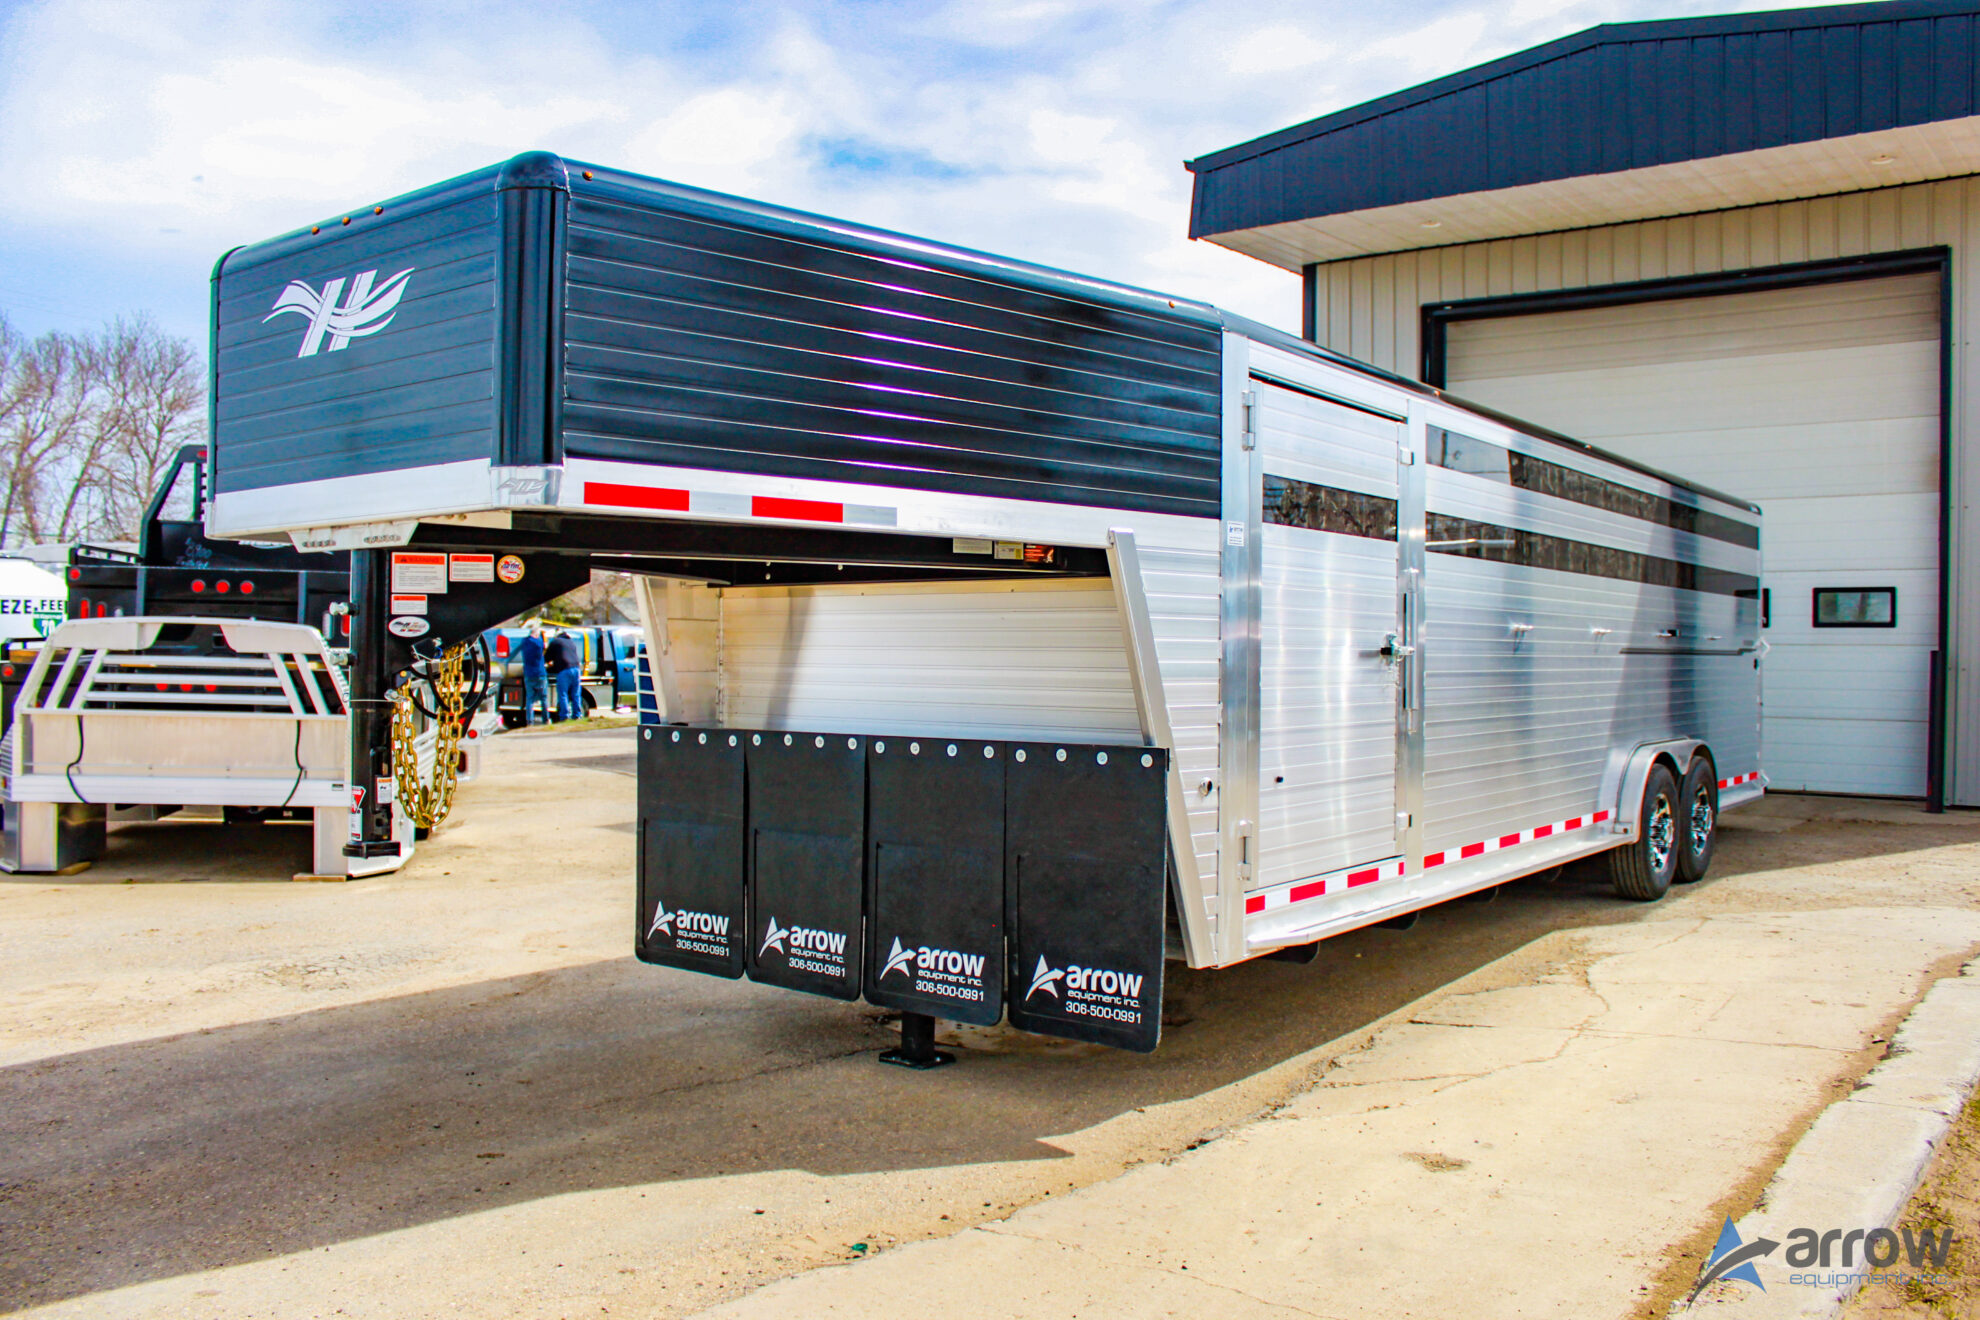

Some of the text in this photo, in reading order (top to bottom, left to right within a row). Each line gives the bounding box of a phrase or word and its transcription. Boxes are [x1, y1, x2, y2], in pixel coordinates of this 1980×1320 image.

[676, 909, 730, 936] arrow
[676, 938, 730, 957] 306-500-0991
[677, 930, 729, 944] equipment inc.
[789, 925, 847, 955] arrow
[790, 947, 845, 964] equipment inc.
[916, 946, 985, 978] arrow
[788, 957, 846, 978] 306-500-0991
[917, 969, 984, 987] equipment inc.
[915, 980, 984, 1002] 306-500-0991
[1066, 965, 1143, 998] arrow
[1067, 989, 1141, 1008] equipment inc.
[1065, 1001, 1142, 1024] 306-500-0991
